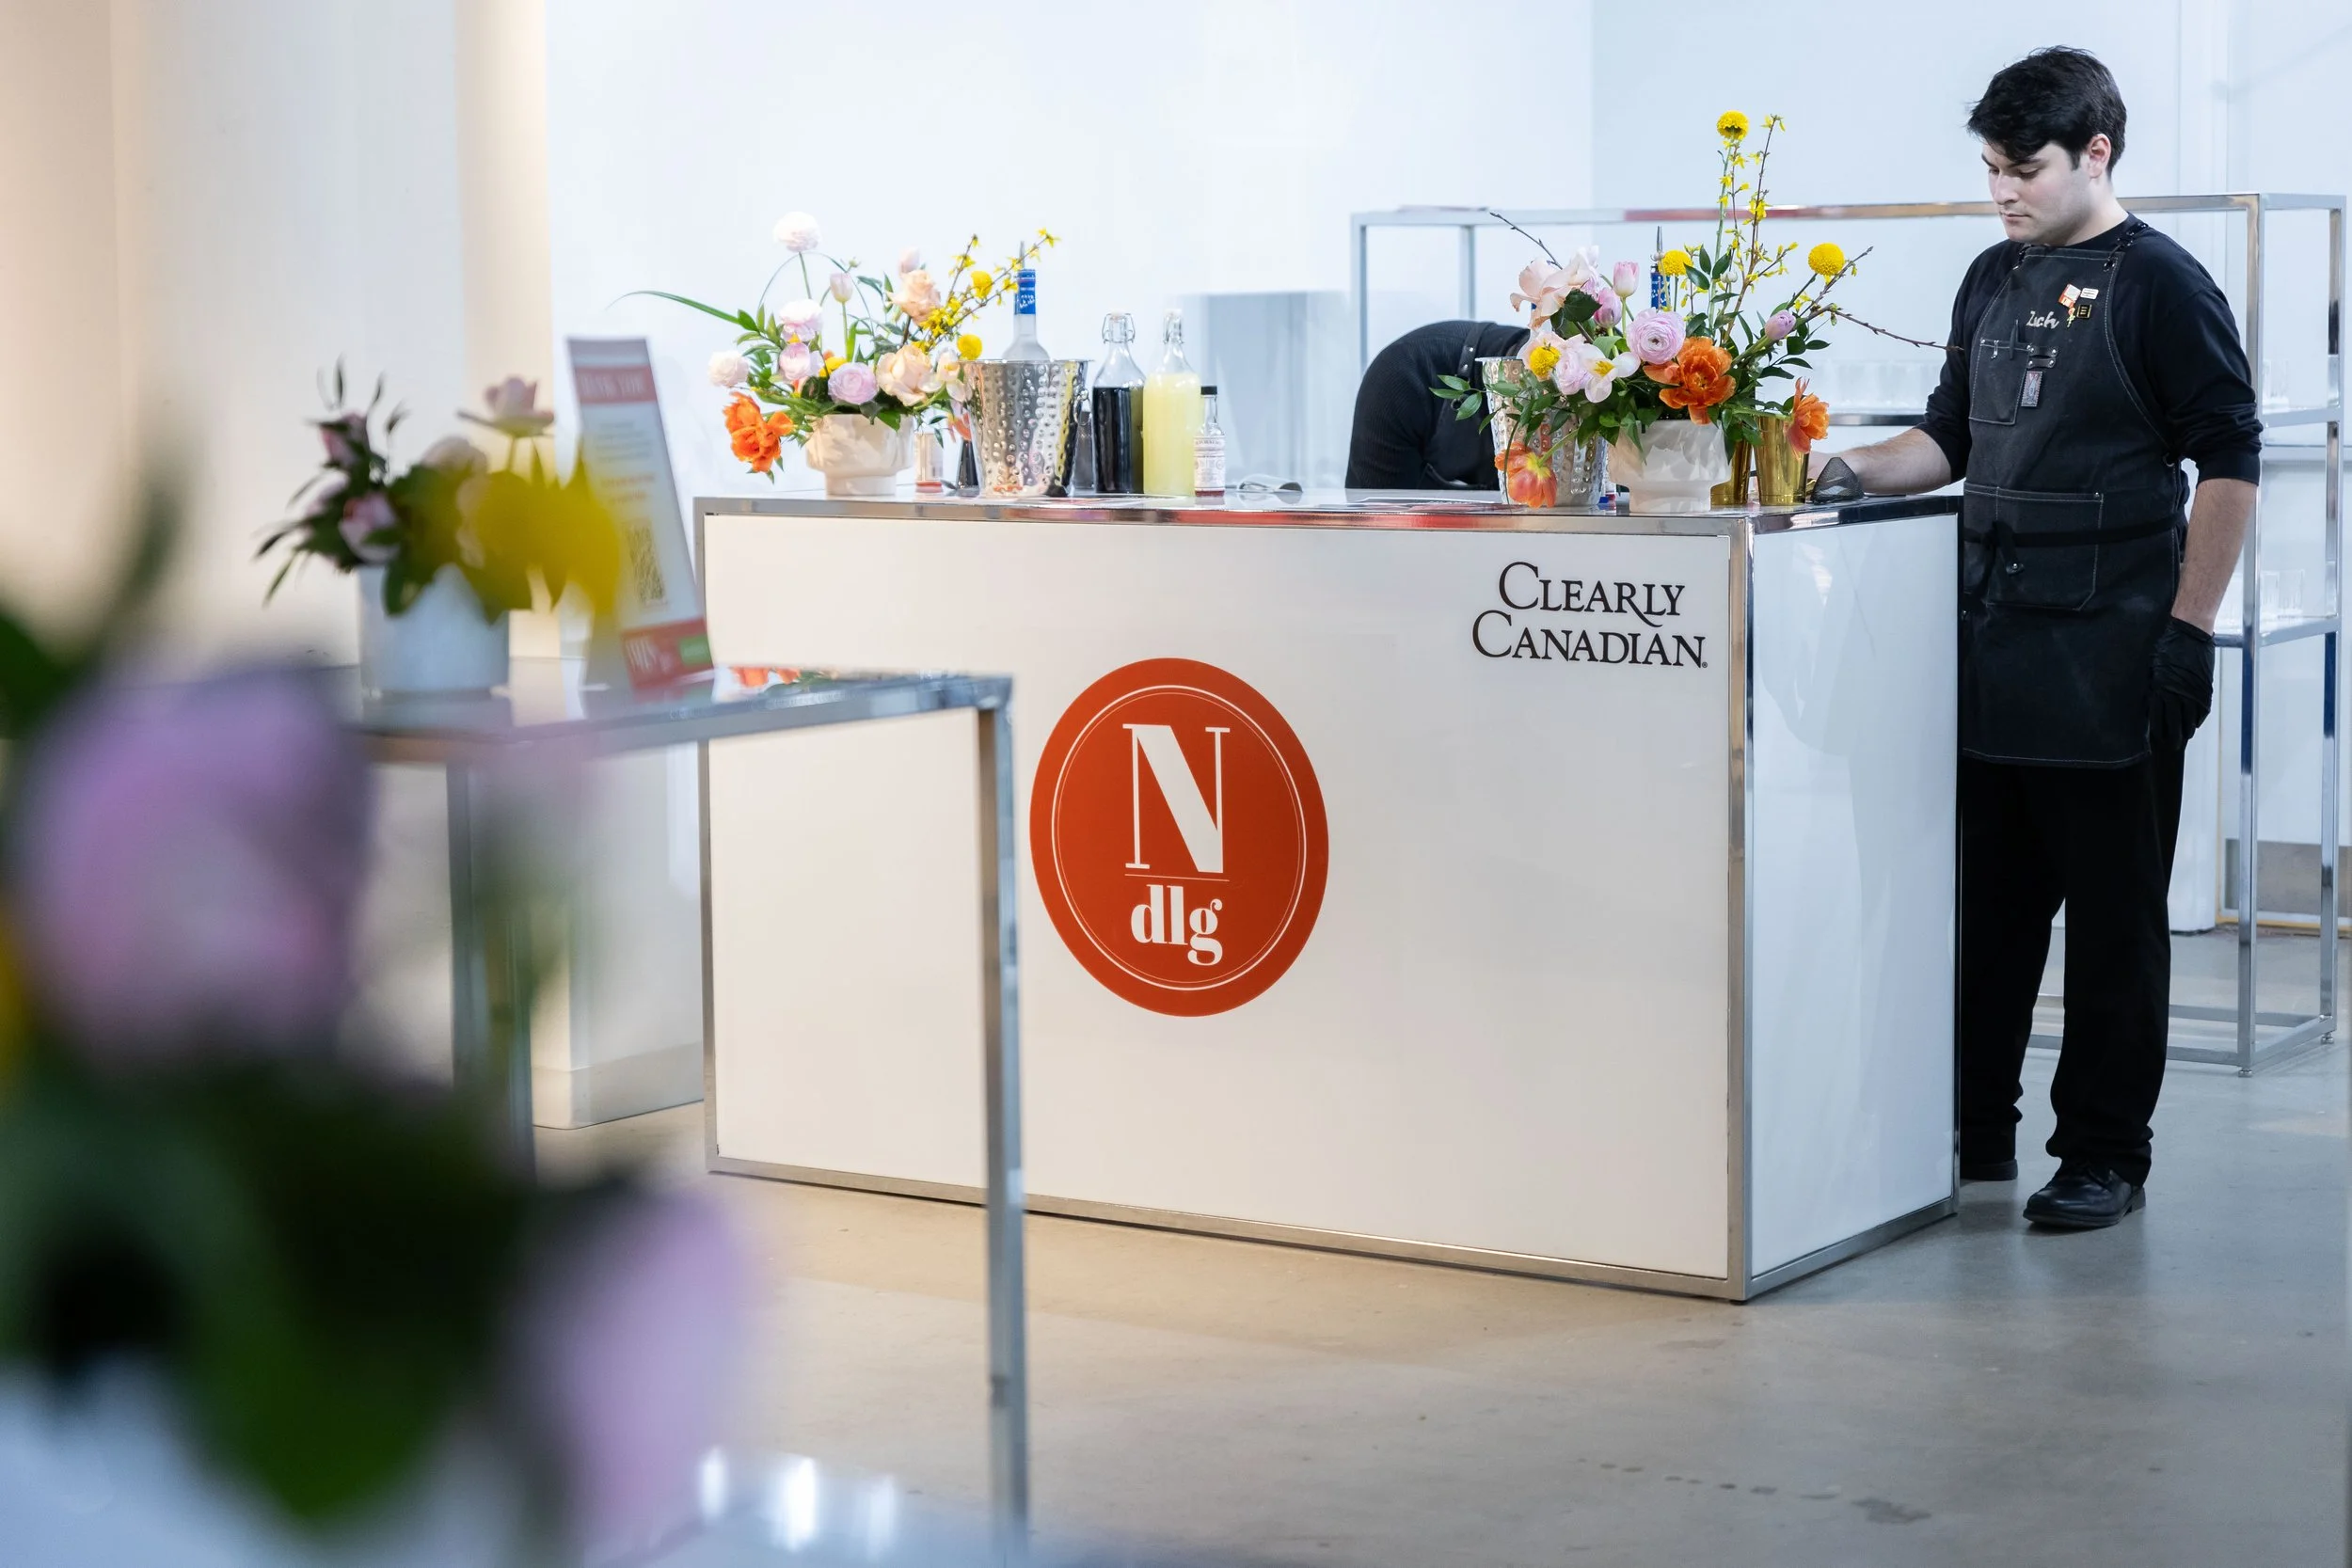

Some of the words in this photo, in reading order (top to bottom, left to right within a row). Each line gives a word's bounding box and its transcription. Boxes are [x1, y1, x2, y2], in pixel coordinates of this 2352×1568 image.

[1499, 561, 1686, 627] CLEARLY
[1121, 722, 1231, 874] N
[1130, 883, 1224, 966] dlg
